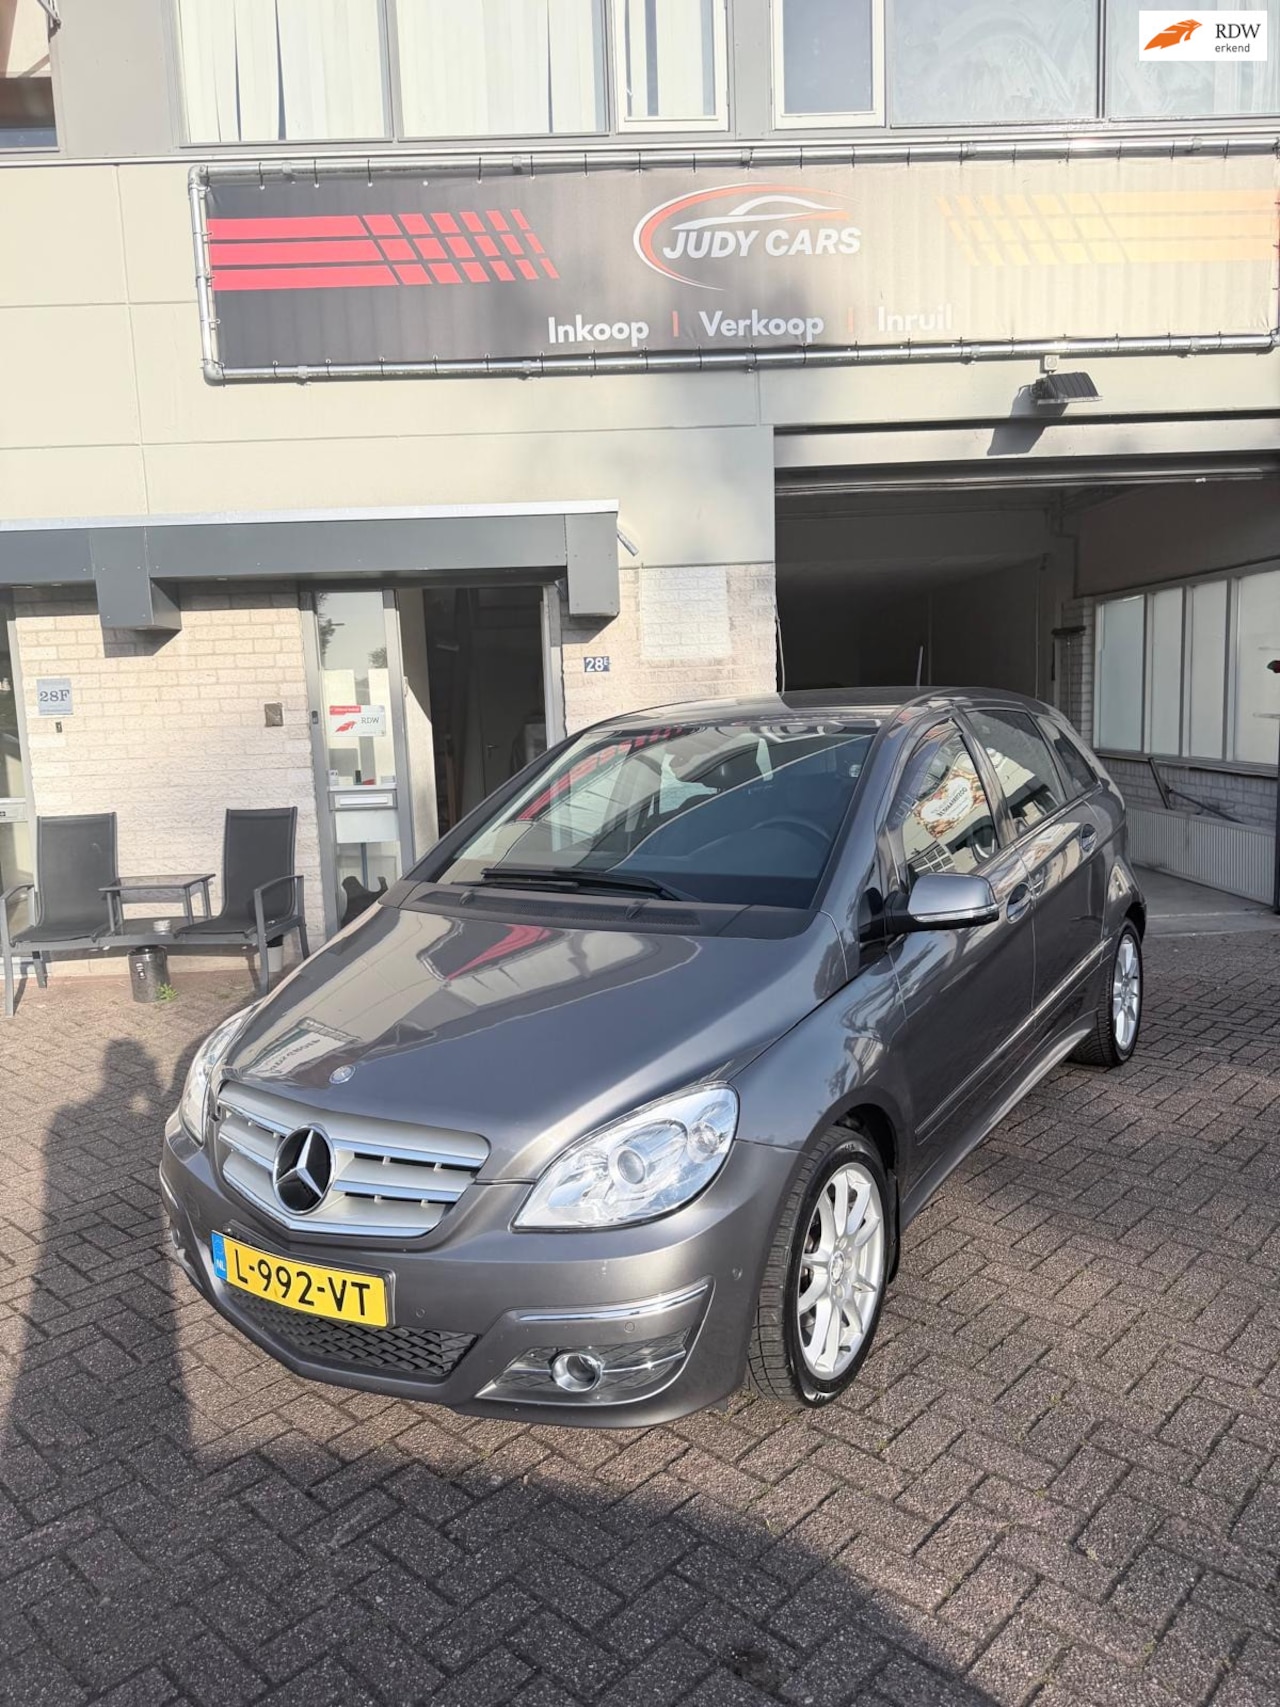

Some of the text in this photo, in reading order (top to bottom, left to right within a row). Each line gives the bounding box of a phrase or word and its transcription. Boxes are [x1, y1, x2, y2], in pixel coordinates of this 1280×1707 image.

[662, 227, 862, 259] JUDY CARS
[547, 304, 952, 347] Inkoop Verkoop Inruil
[39, 689, 70, 702] 28F
[361, 716, 380, 724] RDW
[216, 1259, 226, 1272] NL
[234, 1249, 371, 1316] L-992-VT
